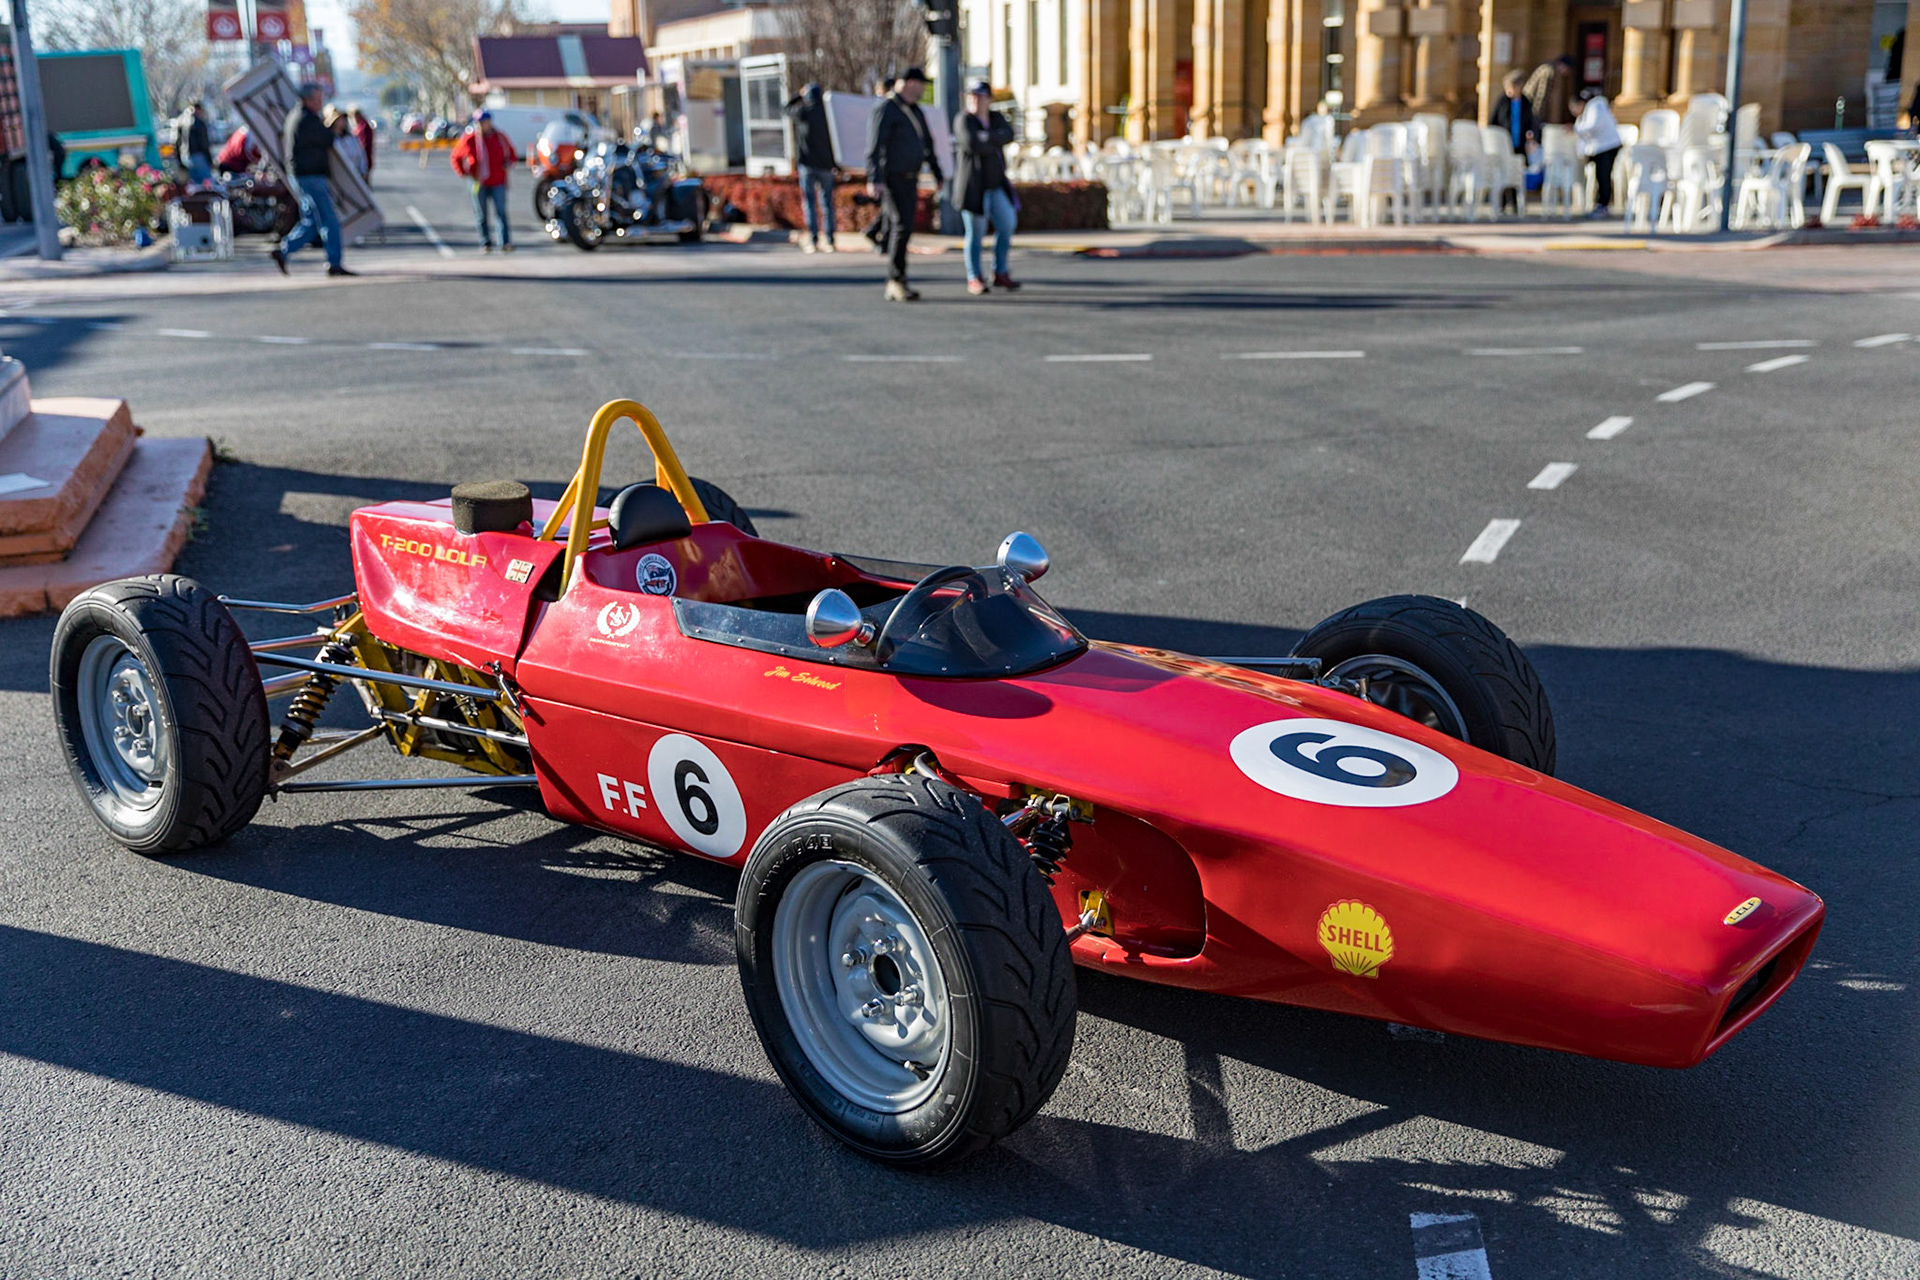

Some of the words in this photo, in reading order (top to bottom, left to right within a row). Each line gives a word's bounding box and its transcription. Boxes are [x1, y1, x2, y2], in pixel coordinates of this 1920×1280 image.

[380, 534, 432, 557] T-200
[434, 545, 488, 569] LOLA
[1269, 731, 1417, 788] 6
[596, 772, 648, 819] F.F
[674, 759, 719, 836] 6
[1327, 924, 1384, 953] SHELL
